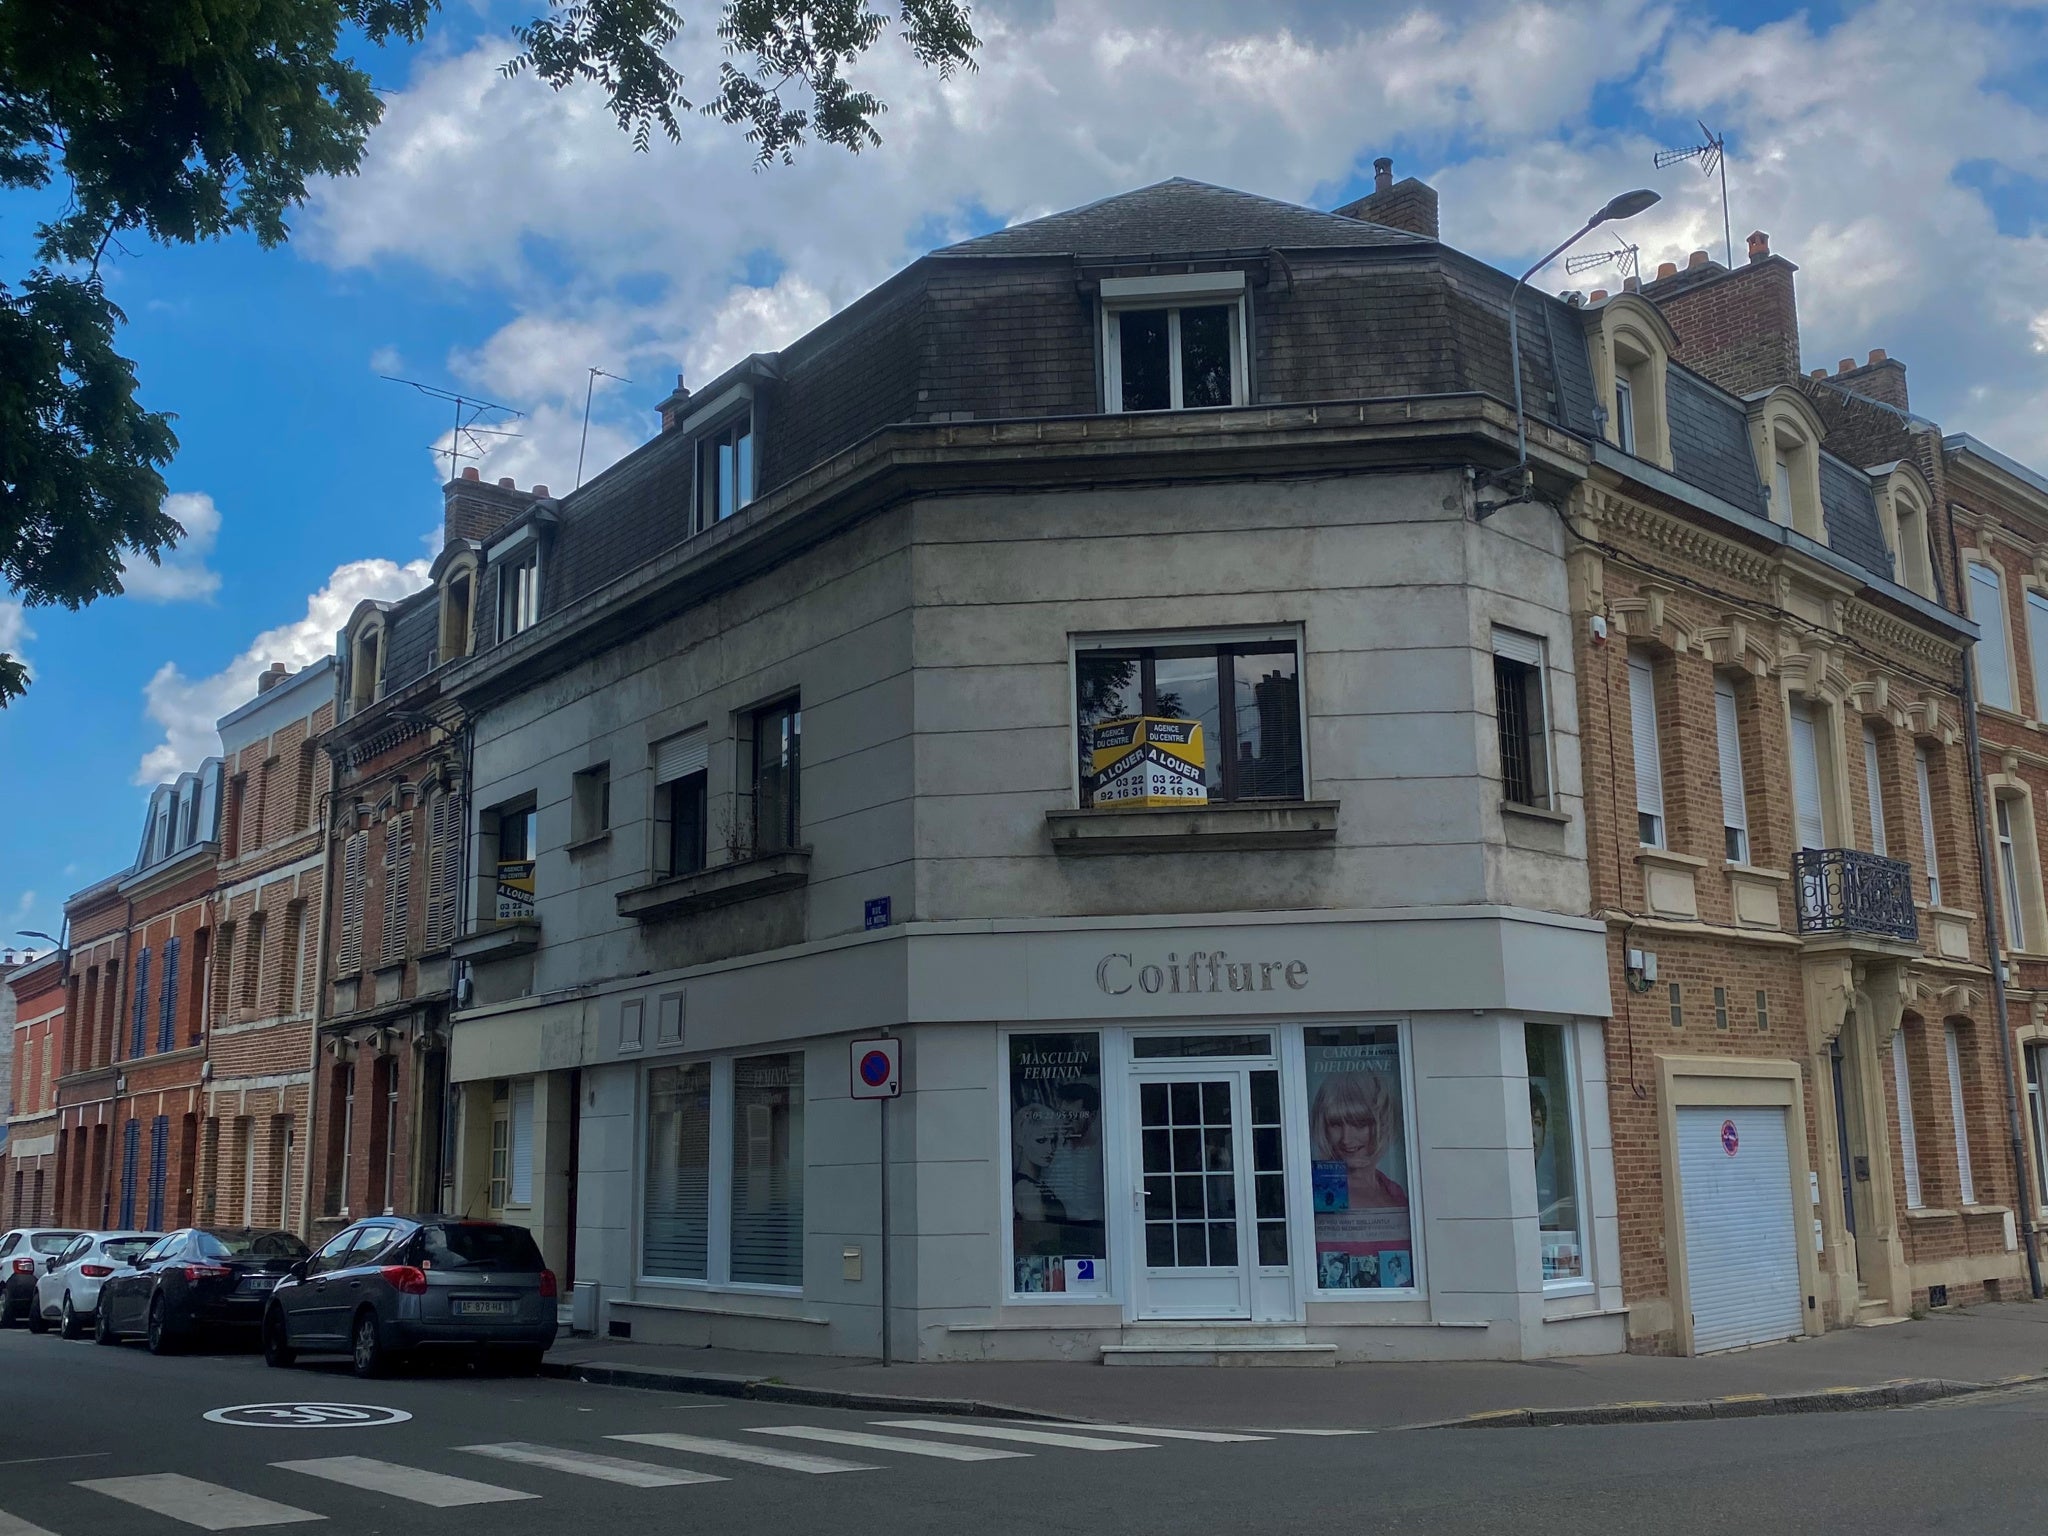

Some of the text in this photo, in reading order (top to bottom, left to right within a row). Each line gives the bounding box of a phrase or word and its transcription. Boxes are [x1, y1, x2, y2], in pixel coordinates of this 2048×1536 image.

[1101, 727, 1125, 738] AGENCE
[1153, 724, 1180, 733] AGENCE
[1096, 736, 1130, 748] DU CENTRE
[1149, 733, 1184, 742] DU CENTRE
[1099, 749, 1145, 785] A LOUER
[1148, 749, 1200, 780] A LOUER
[1115, 774, 1144, 788] 03 22
[1152, 774, 1183, 785] 03 22
[1100, 786, 1144, 801] 92 16 31
[1152, 786, 1200, 796] 92 16 31
[498, 885, 505, 894] A
[1096, 950, 1309, 995] Coiffure
[1019, 1051, 1090, 1065] MASCULIN
[1023, 1065, 1082, 1080] FEMININ
[1313, 1059, 1393, 1073] DIEUDONNE
[241, 1405, 371, 1423] 30
